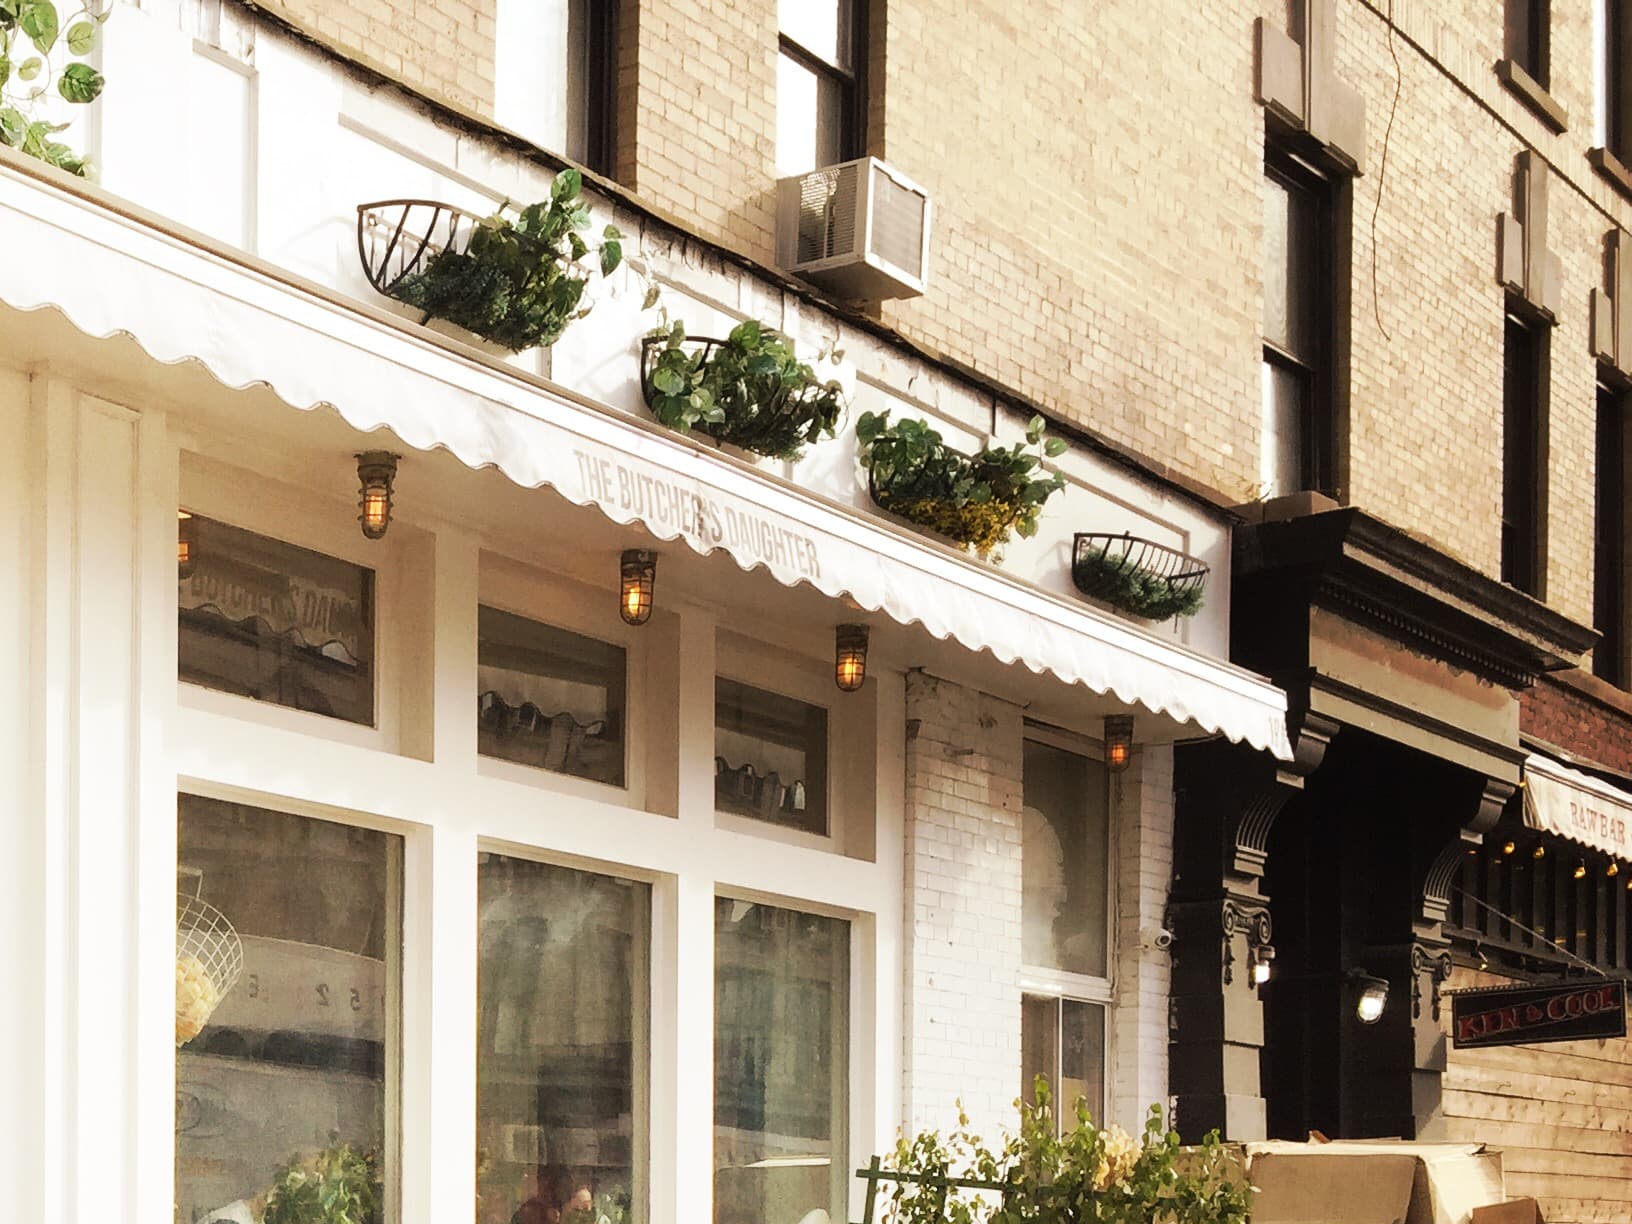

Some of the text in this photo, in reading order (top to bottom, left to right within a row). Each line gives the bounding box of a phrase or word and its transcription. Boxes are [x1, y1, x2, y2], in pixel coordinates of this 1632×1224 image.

[575, 451, 614, 503] THE
[726, 507, 821, 578] DAUGHTER
[1570, 802, 1625, 845] RAW BAR
